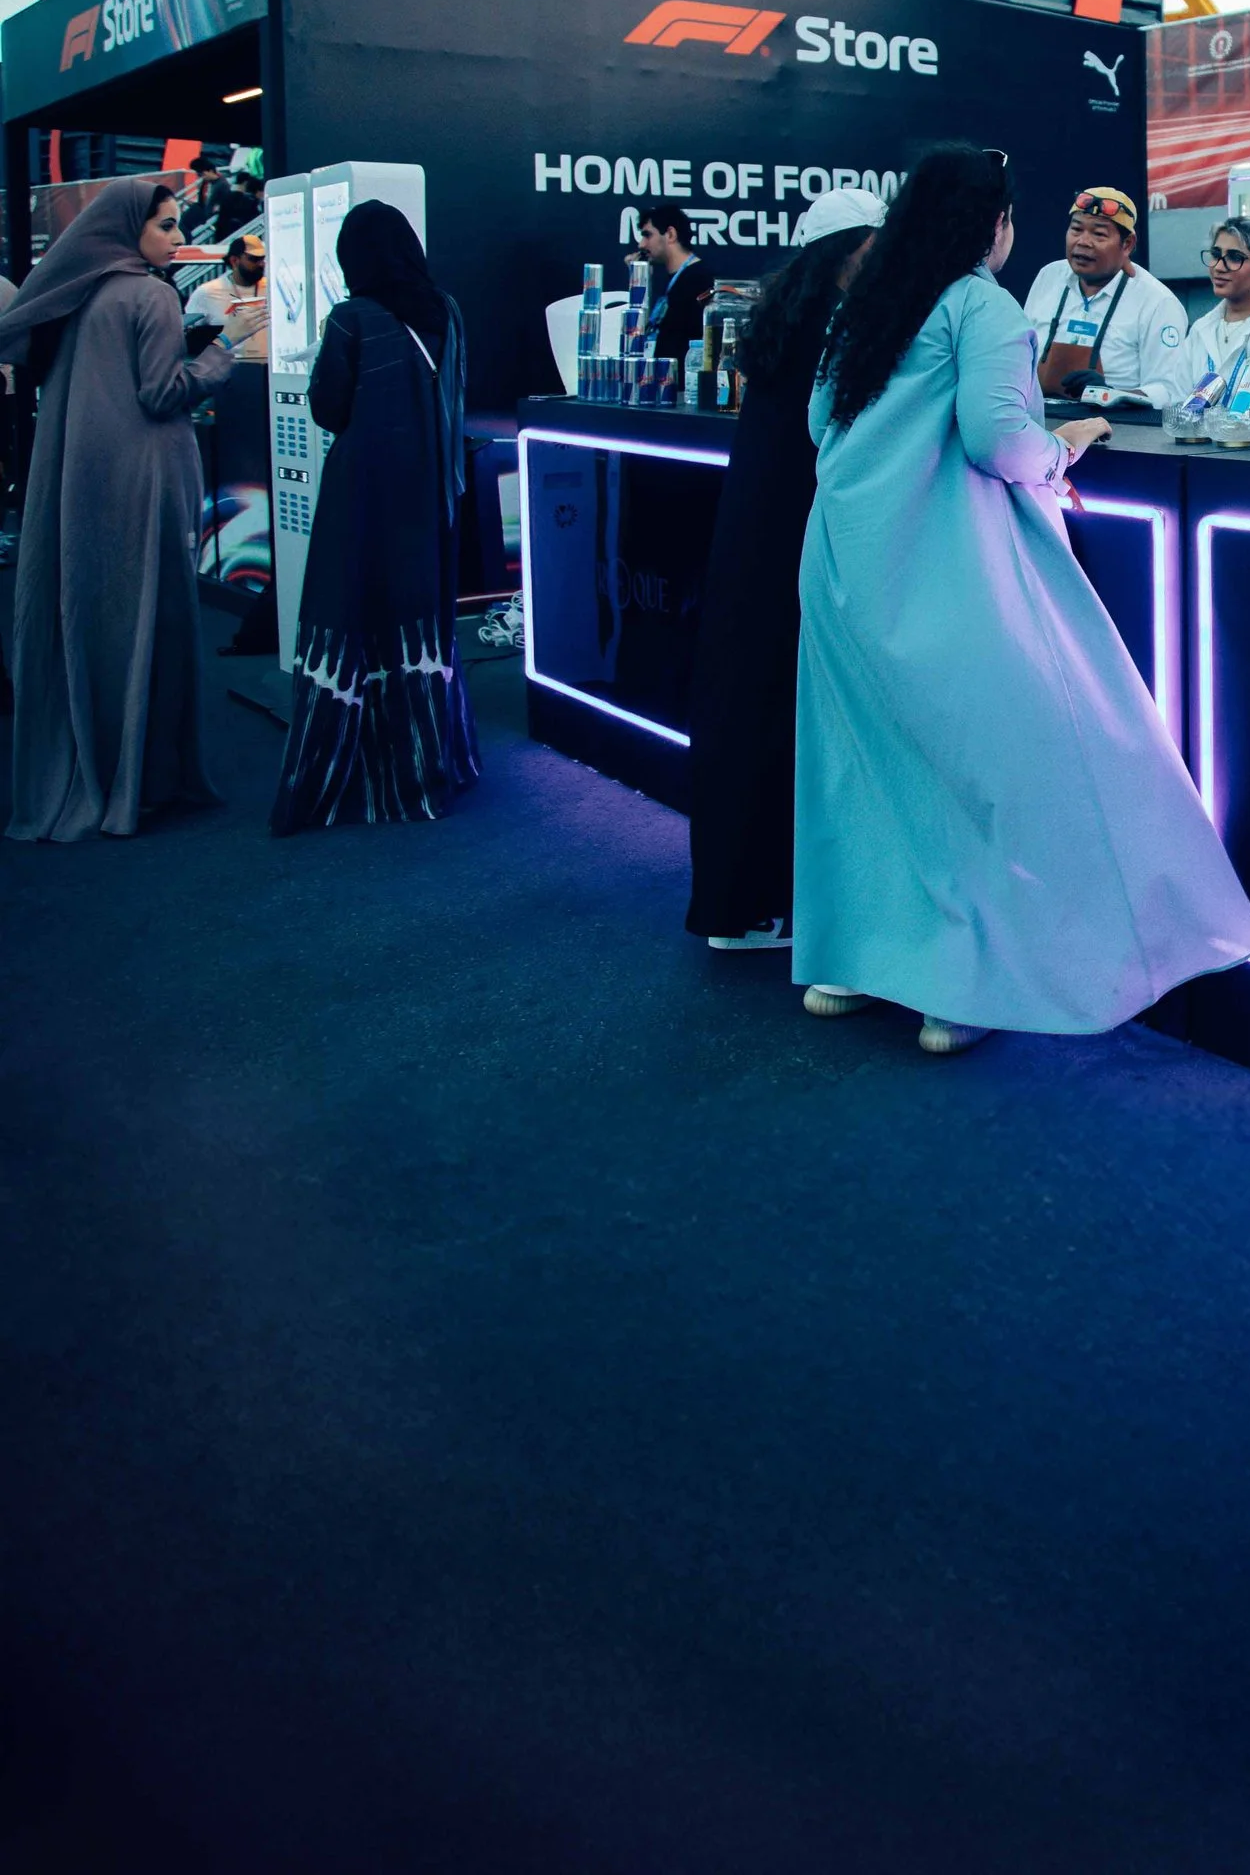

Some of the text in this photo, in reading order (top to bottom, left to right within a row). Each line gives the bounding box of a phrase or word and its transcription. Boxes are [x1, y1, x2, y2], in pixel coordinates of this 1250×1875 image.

[795, 15, 939, 76] Store
[534, 142, 909, 203] HOME OF FORM
